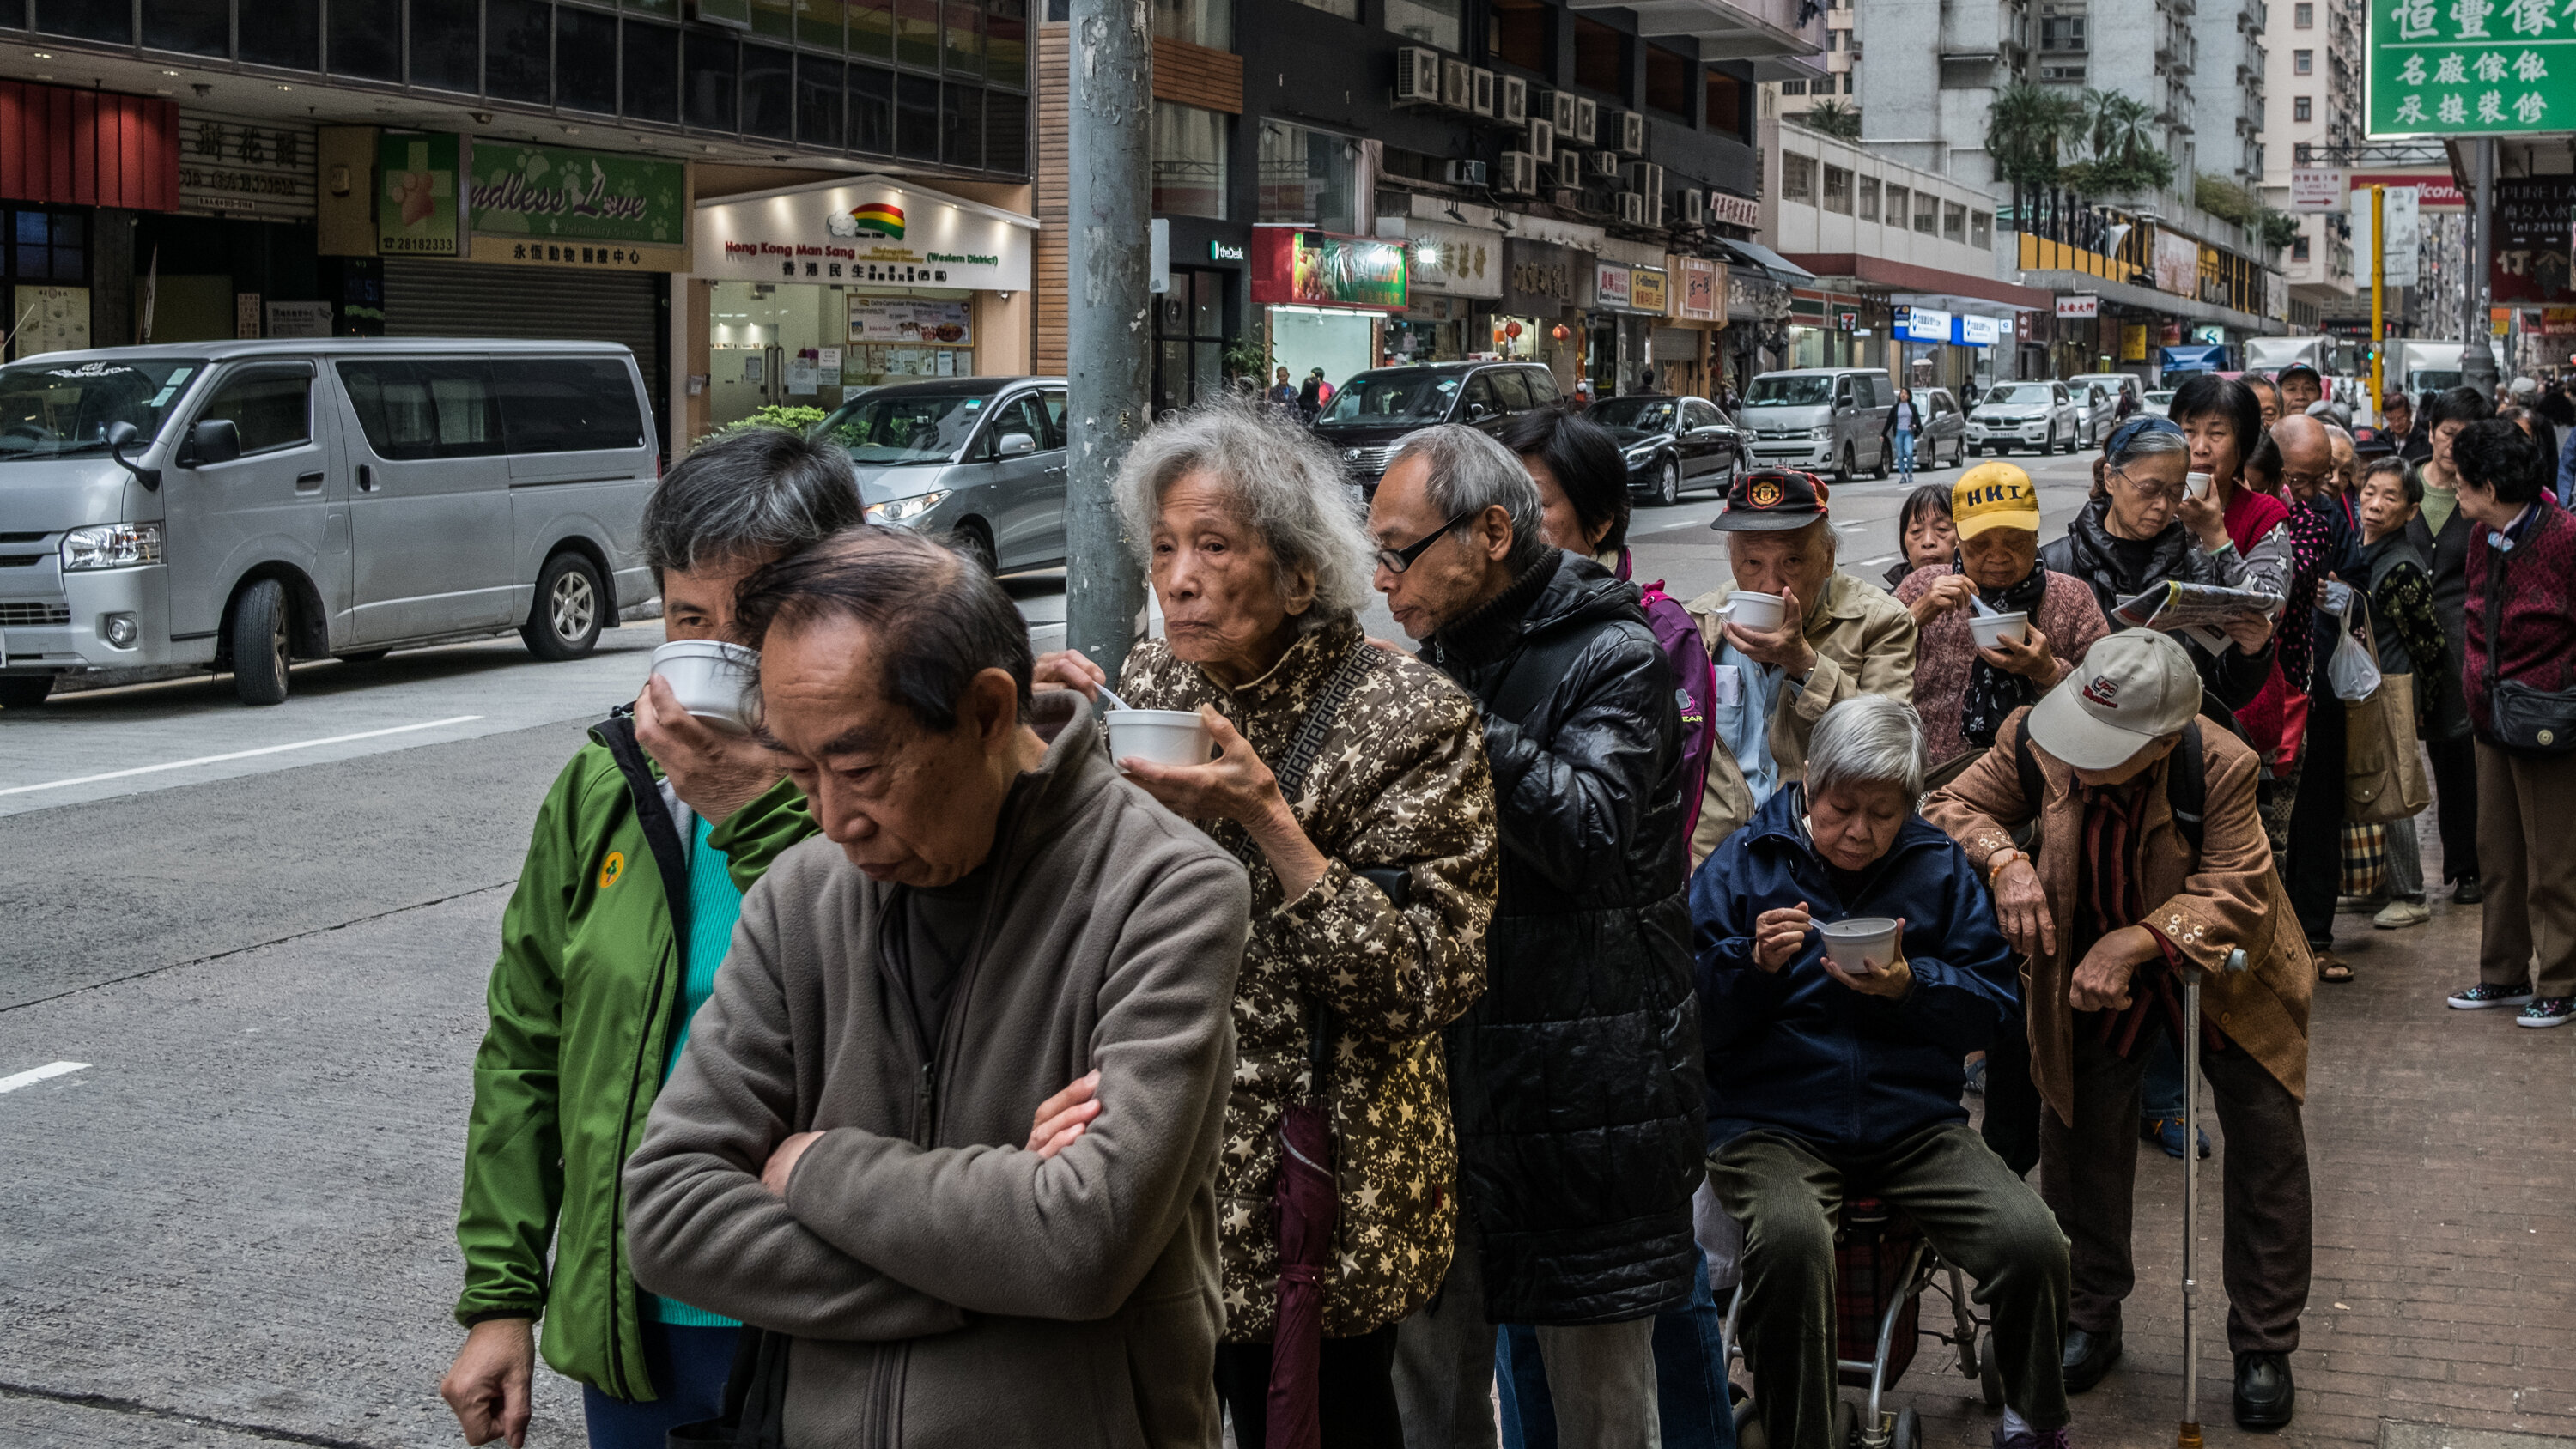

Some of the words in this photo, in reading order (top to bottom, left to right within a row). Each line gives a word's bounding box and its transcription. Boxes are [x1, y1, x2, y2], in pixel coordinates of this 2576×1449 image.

[2391, 0, 2576, 40] 恒豐傢
[2395, 50, 2549, 88] 名廠傢俬
[2393, 89, 2548, 125] 承接裝修
[471, 171, 567, 216] ndless
[574, 172, 647, 221] Love
[2417, 181, 2464, 198] llcom
[2500, 185, 2547, 199] PURE
[398, 238, 453, 252] 28182333
[725, 241, 757, 256] Hong
[760, 242, 793, 258] Kong
[796, 244, 822, 257] Man
[825, 246, 855, 260] Sang
[927, 252, 966, 264] (Western
[967, 254, 999, 266] District)
[782, 261, 865, 279] 香港民生
[2057, 302, 2095, 313] 永安大押
[1967, 484, 2024, 508] HKI
